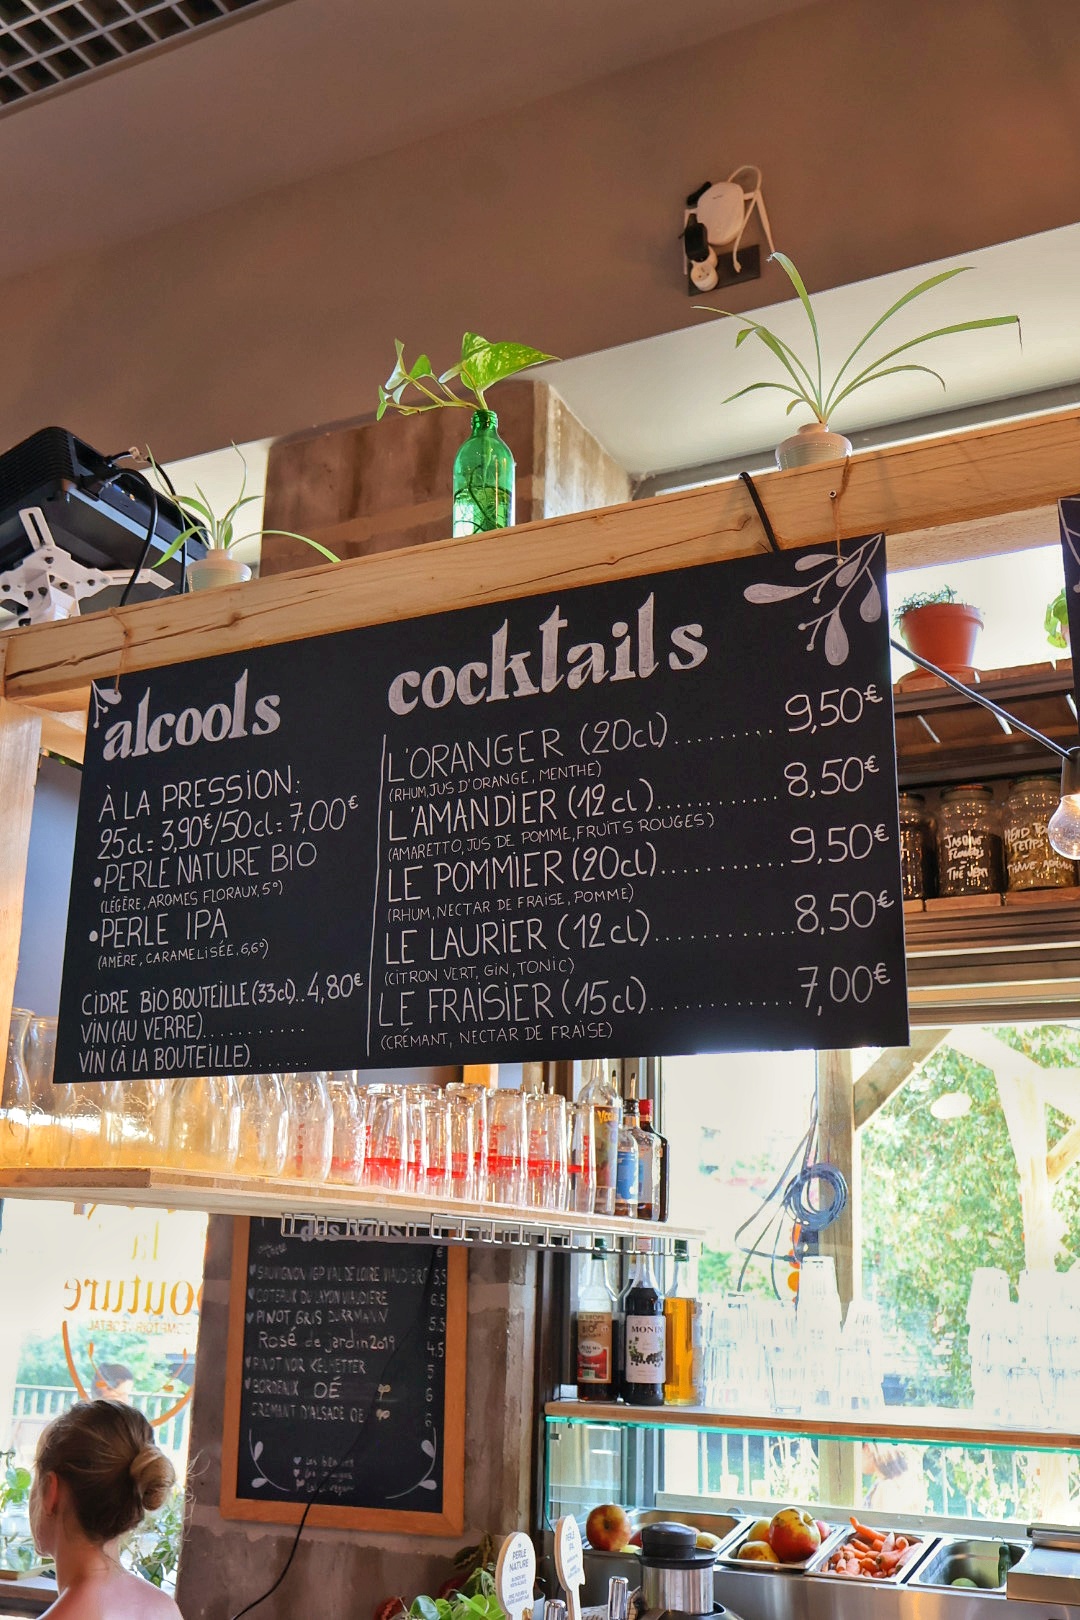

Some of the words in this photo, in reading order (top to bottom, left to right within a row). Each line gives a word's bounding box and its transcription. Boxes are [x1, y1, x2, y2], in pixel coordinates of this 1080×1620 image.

[388, 591, 708, 715] cocktails
[102, 668, 281, 761] alcools
[388, 728, 563, 782] L'ORANGER
[580, 712, 668, 755] (20cl)
[785, 684, 882, 734] 9,50€
[539, 760, 602, 780] MENTHE)
[98, 785, 116, 822] À
[124, 790, 150, 819] LA
[290, 795, 359, 834] 7,00€
[388, 789, 556, 841] L'AMANDIER
[784, 754, 879, 798] 8,50€
[467, 837, 490, 852] JUS
[495, 833, 514, 849] DE
[639, 812, 714, 830] ROUGES)
[103, 859, 169, 893] PERLE
[177, 846, 260, 885] NATURE
[271, 842, 316, 873] BIO
[388, 865, 422, 902] LE
[434, 850, 564, 895] POMMIER
[572, 841, 656, 881] (20cl)
[790, 823, 889, 864] 9,50€
[148, 892, 197, 910] AROMES
[437, 902, 490, 917] NECTAR
[497, 898, 514, 912] DE
[575, 883, 634, 904] POMME)
[100, 913, 168, 948] PERLE
[186, 907, 228, 940] IPA
[385, 929, 417, 964] LE
[430, 918, 547, 961] LAURIER
[794, 890, 895, 935] 8,50€
[384, 969, 438, 986] (CITRON
[516, 957, 574, 975] TONIC)
[81, 989, 128, 1016] CIDRE
[140, 987, 169, 1014] BIO
[307, 971, 363, 1005] 4,80€
[379, 991, 415, 1026] LE
[428, 981, 553, 1023] FRAISIER
[797, 962, 890, 1016] 7,00€
[459, 1028, 519, 1044] NECTAR
[525, 1024, 544, 1041] DE
[551, 1022, 613, 1041] FRAISE)
[78, 1047, 105, 1073] VIN
[132, 1047, 149, 1072] LA
[154, 1043, 251, 1071] BOUTEILLE)
[259, 1326, 297, 1349] Rosé
